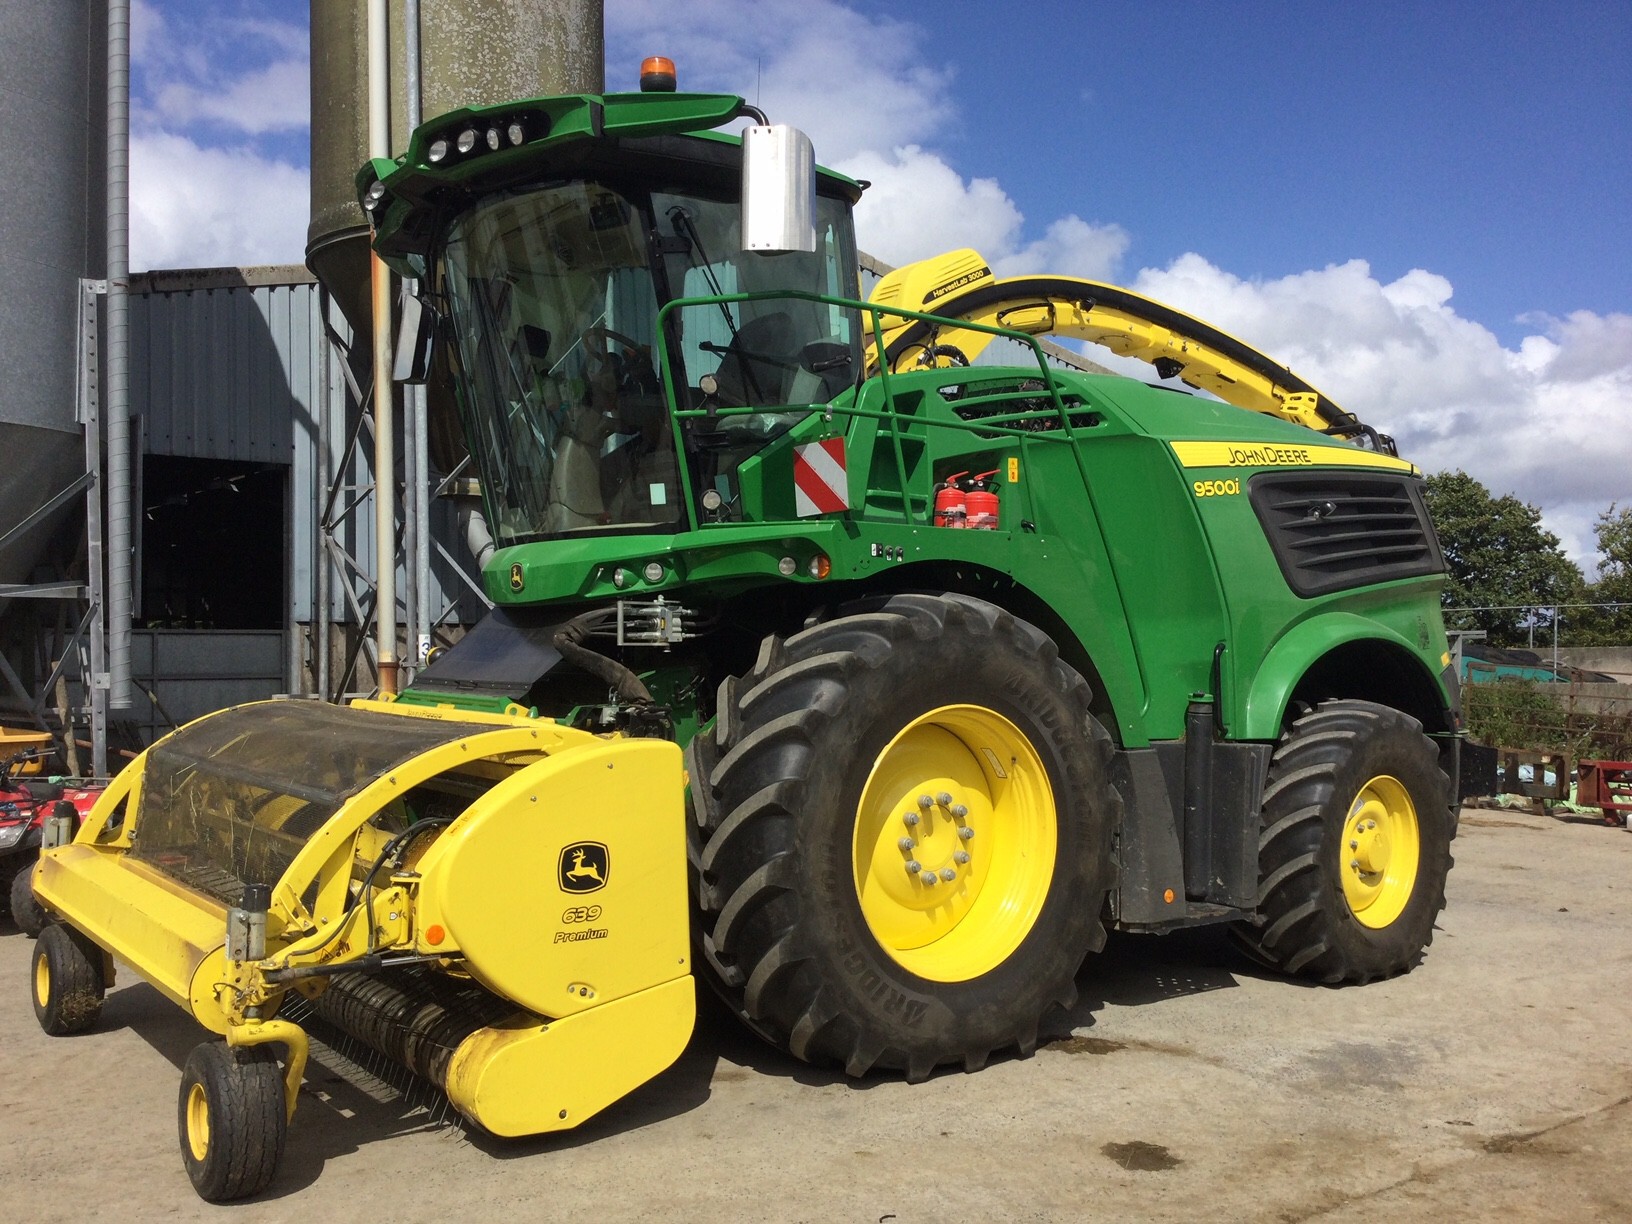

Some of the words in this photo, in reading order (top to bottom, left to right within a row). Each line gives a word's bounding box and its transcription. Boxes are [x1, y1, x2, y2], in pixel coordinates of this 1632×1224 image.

[932, 277, 968, 298] HarvestLab
[967, 270, 984, 282] 3000
[1193, 477, 1240, 498] 9500i
[562, 905, 602, 924] 639
[553, 928, 609, 944] Premium
